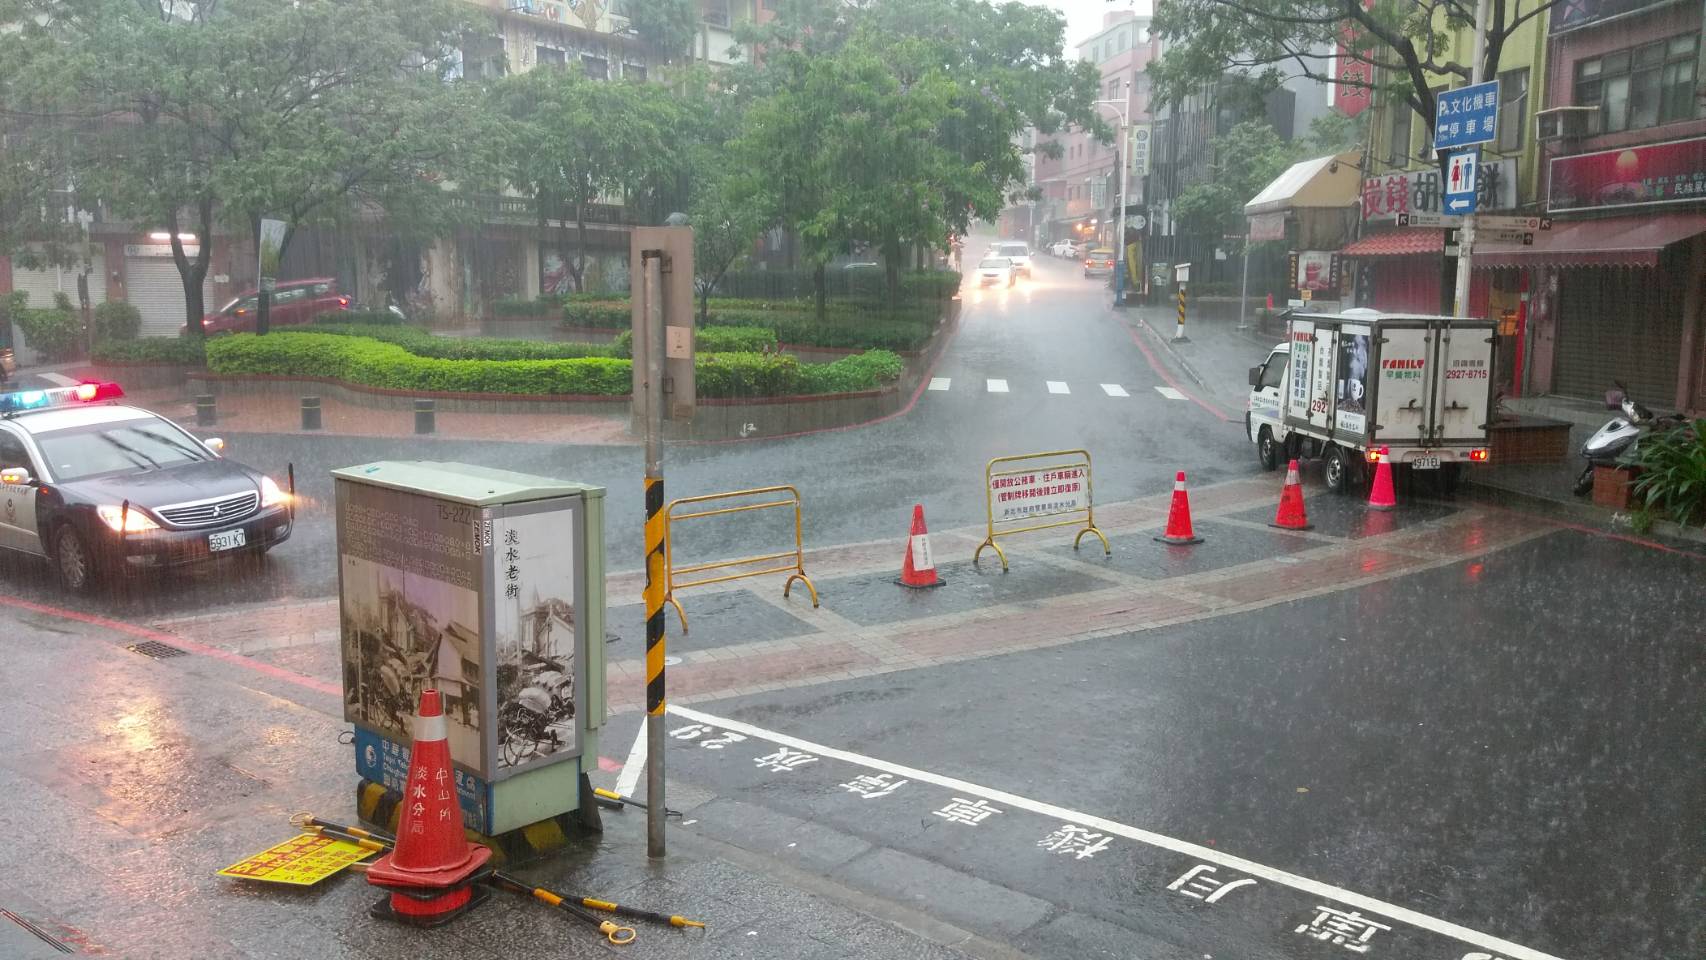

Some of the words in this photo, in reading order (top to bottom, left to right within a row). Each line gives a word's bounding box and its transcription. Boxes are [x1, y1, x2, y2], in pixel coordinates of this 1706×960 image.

[1451, 92, 1496, 114] 文化機車
[1449, 116, 1494, 138] 停車場
[1363, 163, 1499, 220] 炭錢胡餅
[1383, 359, 1424, 369] FAMILY
[1446, 370, 1487, 379] 2927-8715
[210, 536, 232, 550] 5931
[233, 533, 244, 545] K7
[504, 528, 520, 600] 淡水老街
[411, 765, 428, 835] 淡水分局
